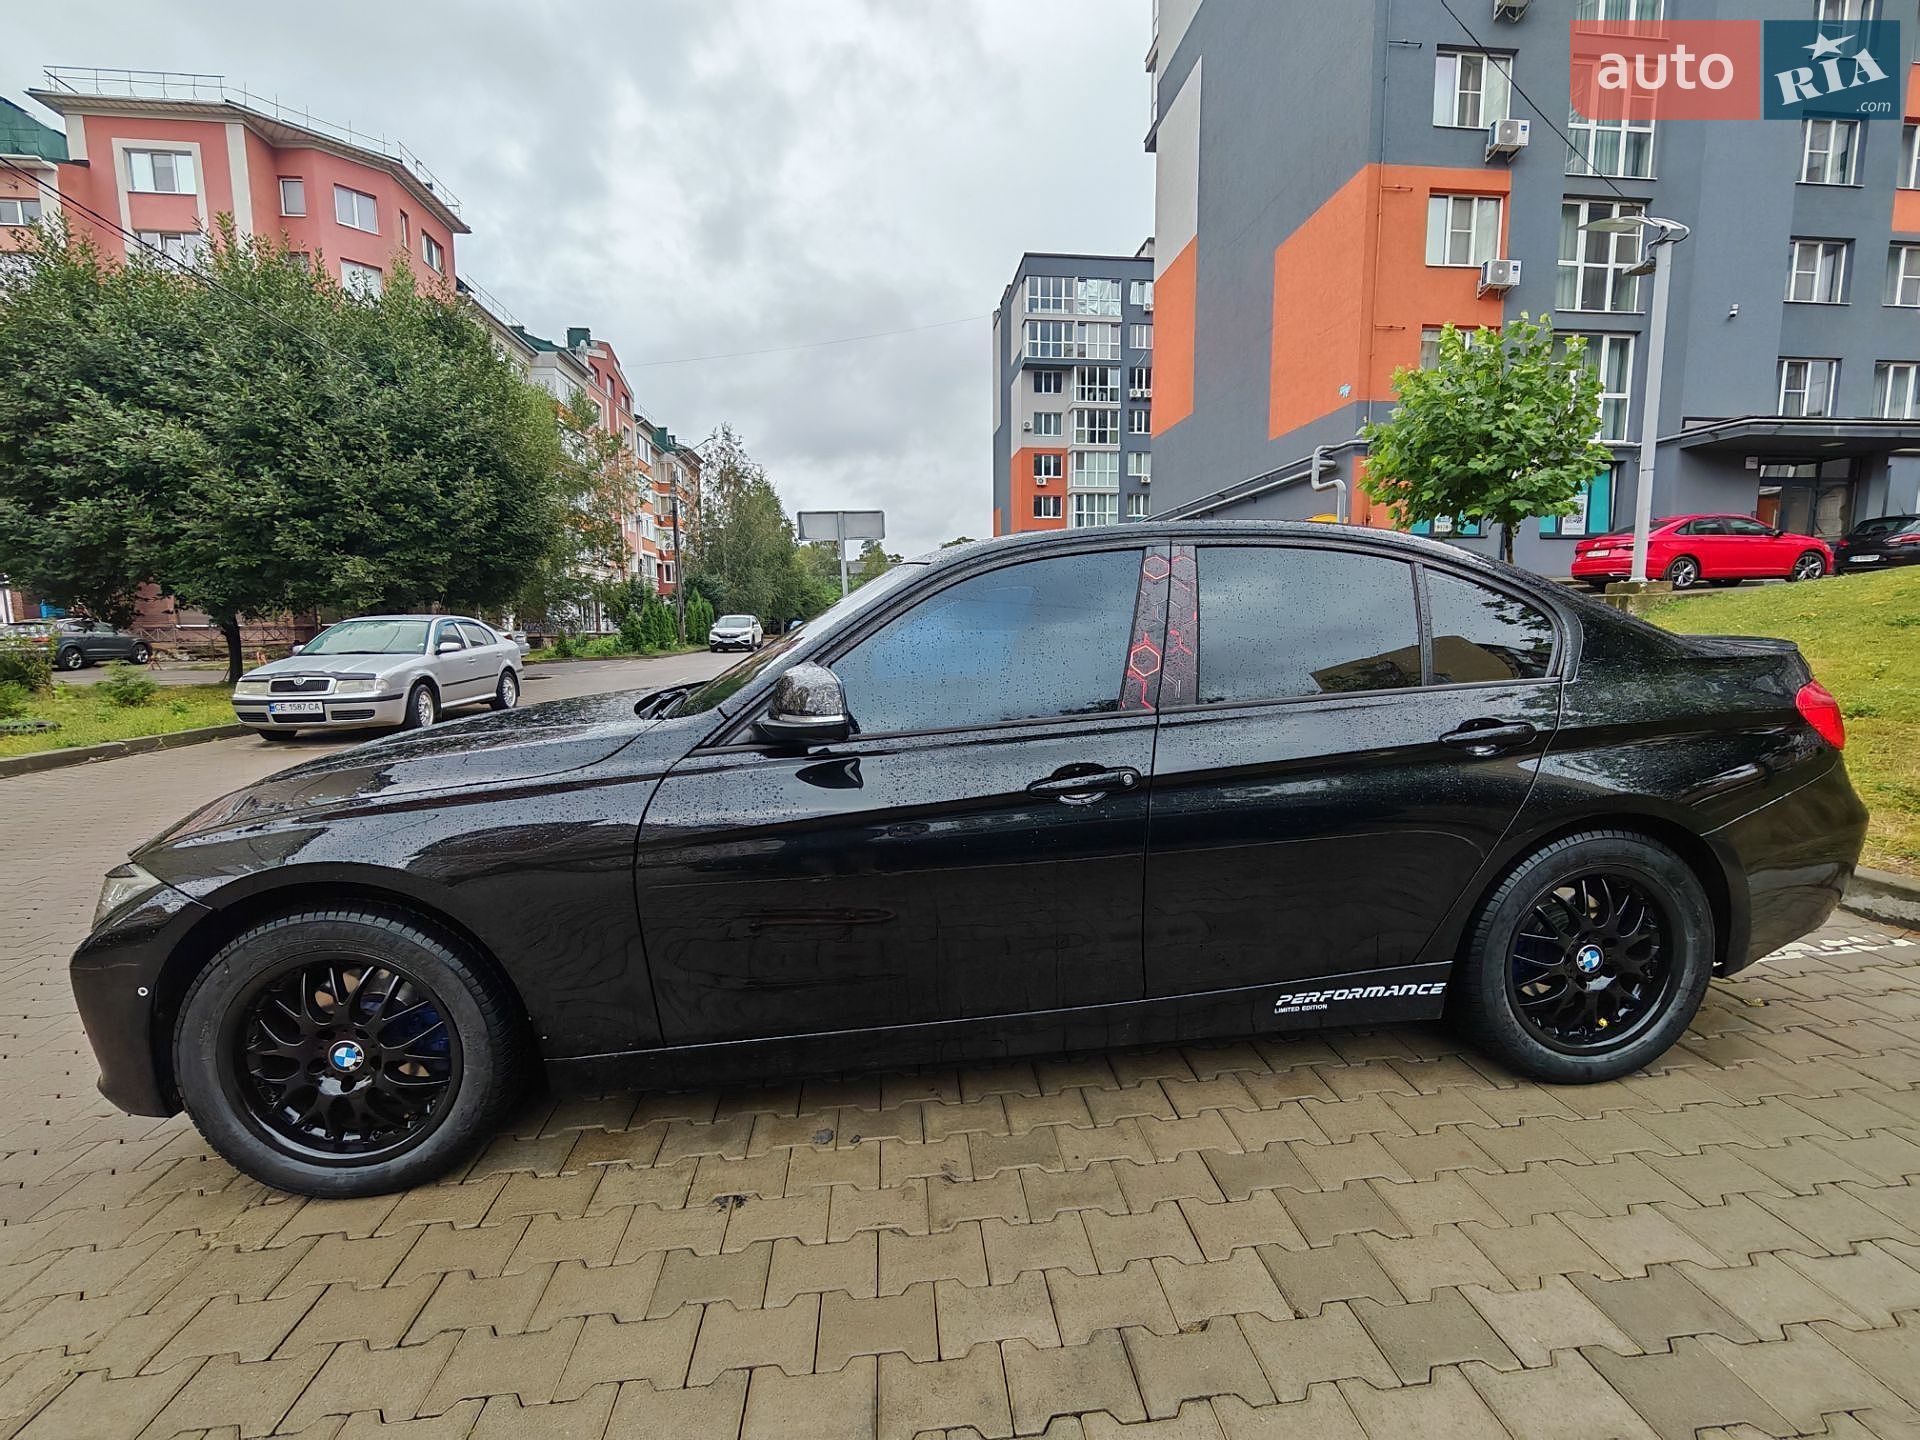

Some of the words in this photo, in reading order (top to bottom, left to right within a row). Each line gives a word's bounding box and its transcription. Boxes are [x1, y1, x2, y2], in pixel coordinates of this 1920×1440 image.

[275, 703, 286, 711] CE
[289, 703, 306, 711] 1587
[1275, 982, 1447, 1007] PERFORMANCE
[1274, 1006, 1300, 1014] LIMITED
[1301, 1003, 1328, 1012] EDITION
